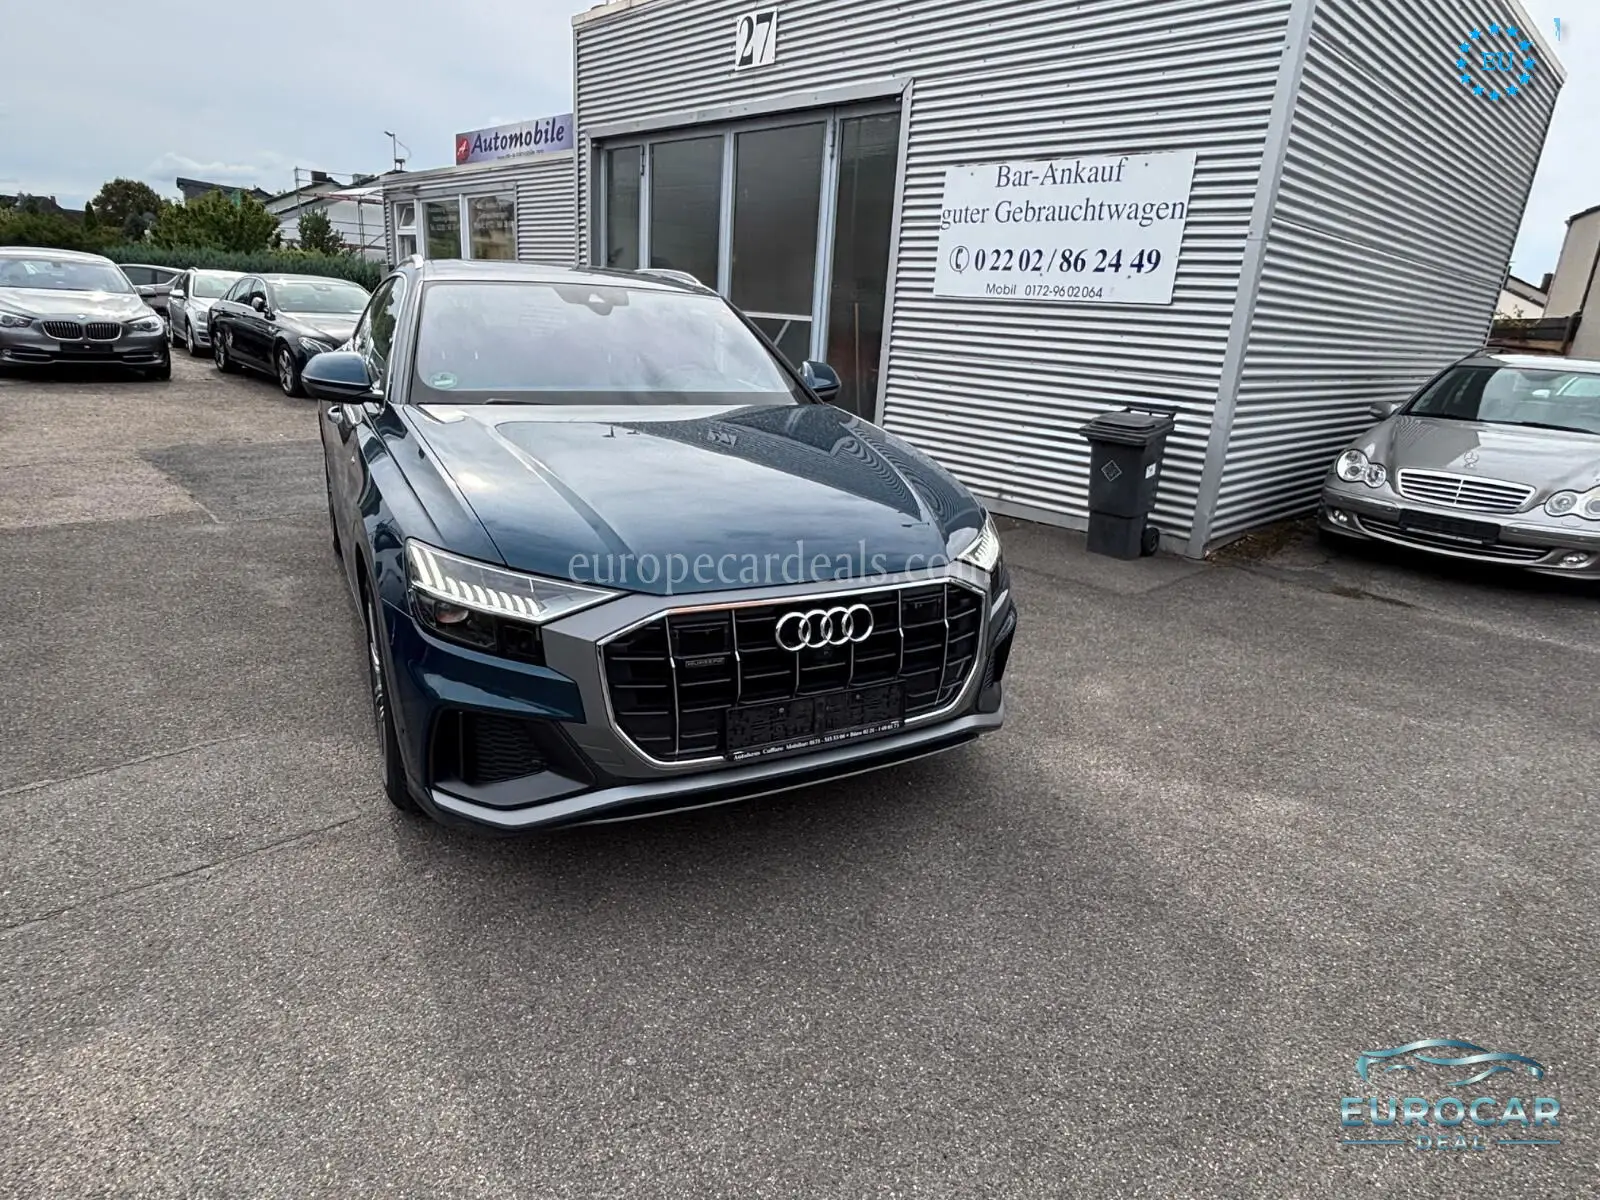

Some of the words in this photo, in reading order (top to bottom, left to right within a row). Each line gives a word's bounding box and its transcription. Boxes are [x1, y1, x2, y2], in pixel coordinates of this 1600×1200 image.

[738, 11, 775, 67] 27
[471, 117, 565, 154] Automobile
[995, 156, 1129, 188] Bar-Ankauf
[940, 205, 989, 231] guter
[995, 197, 1185, 227] Gebrauchtwagen
[985, 283, 1017, 295] Mobil
